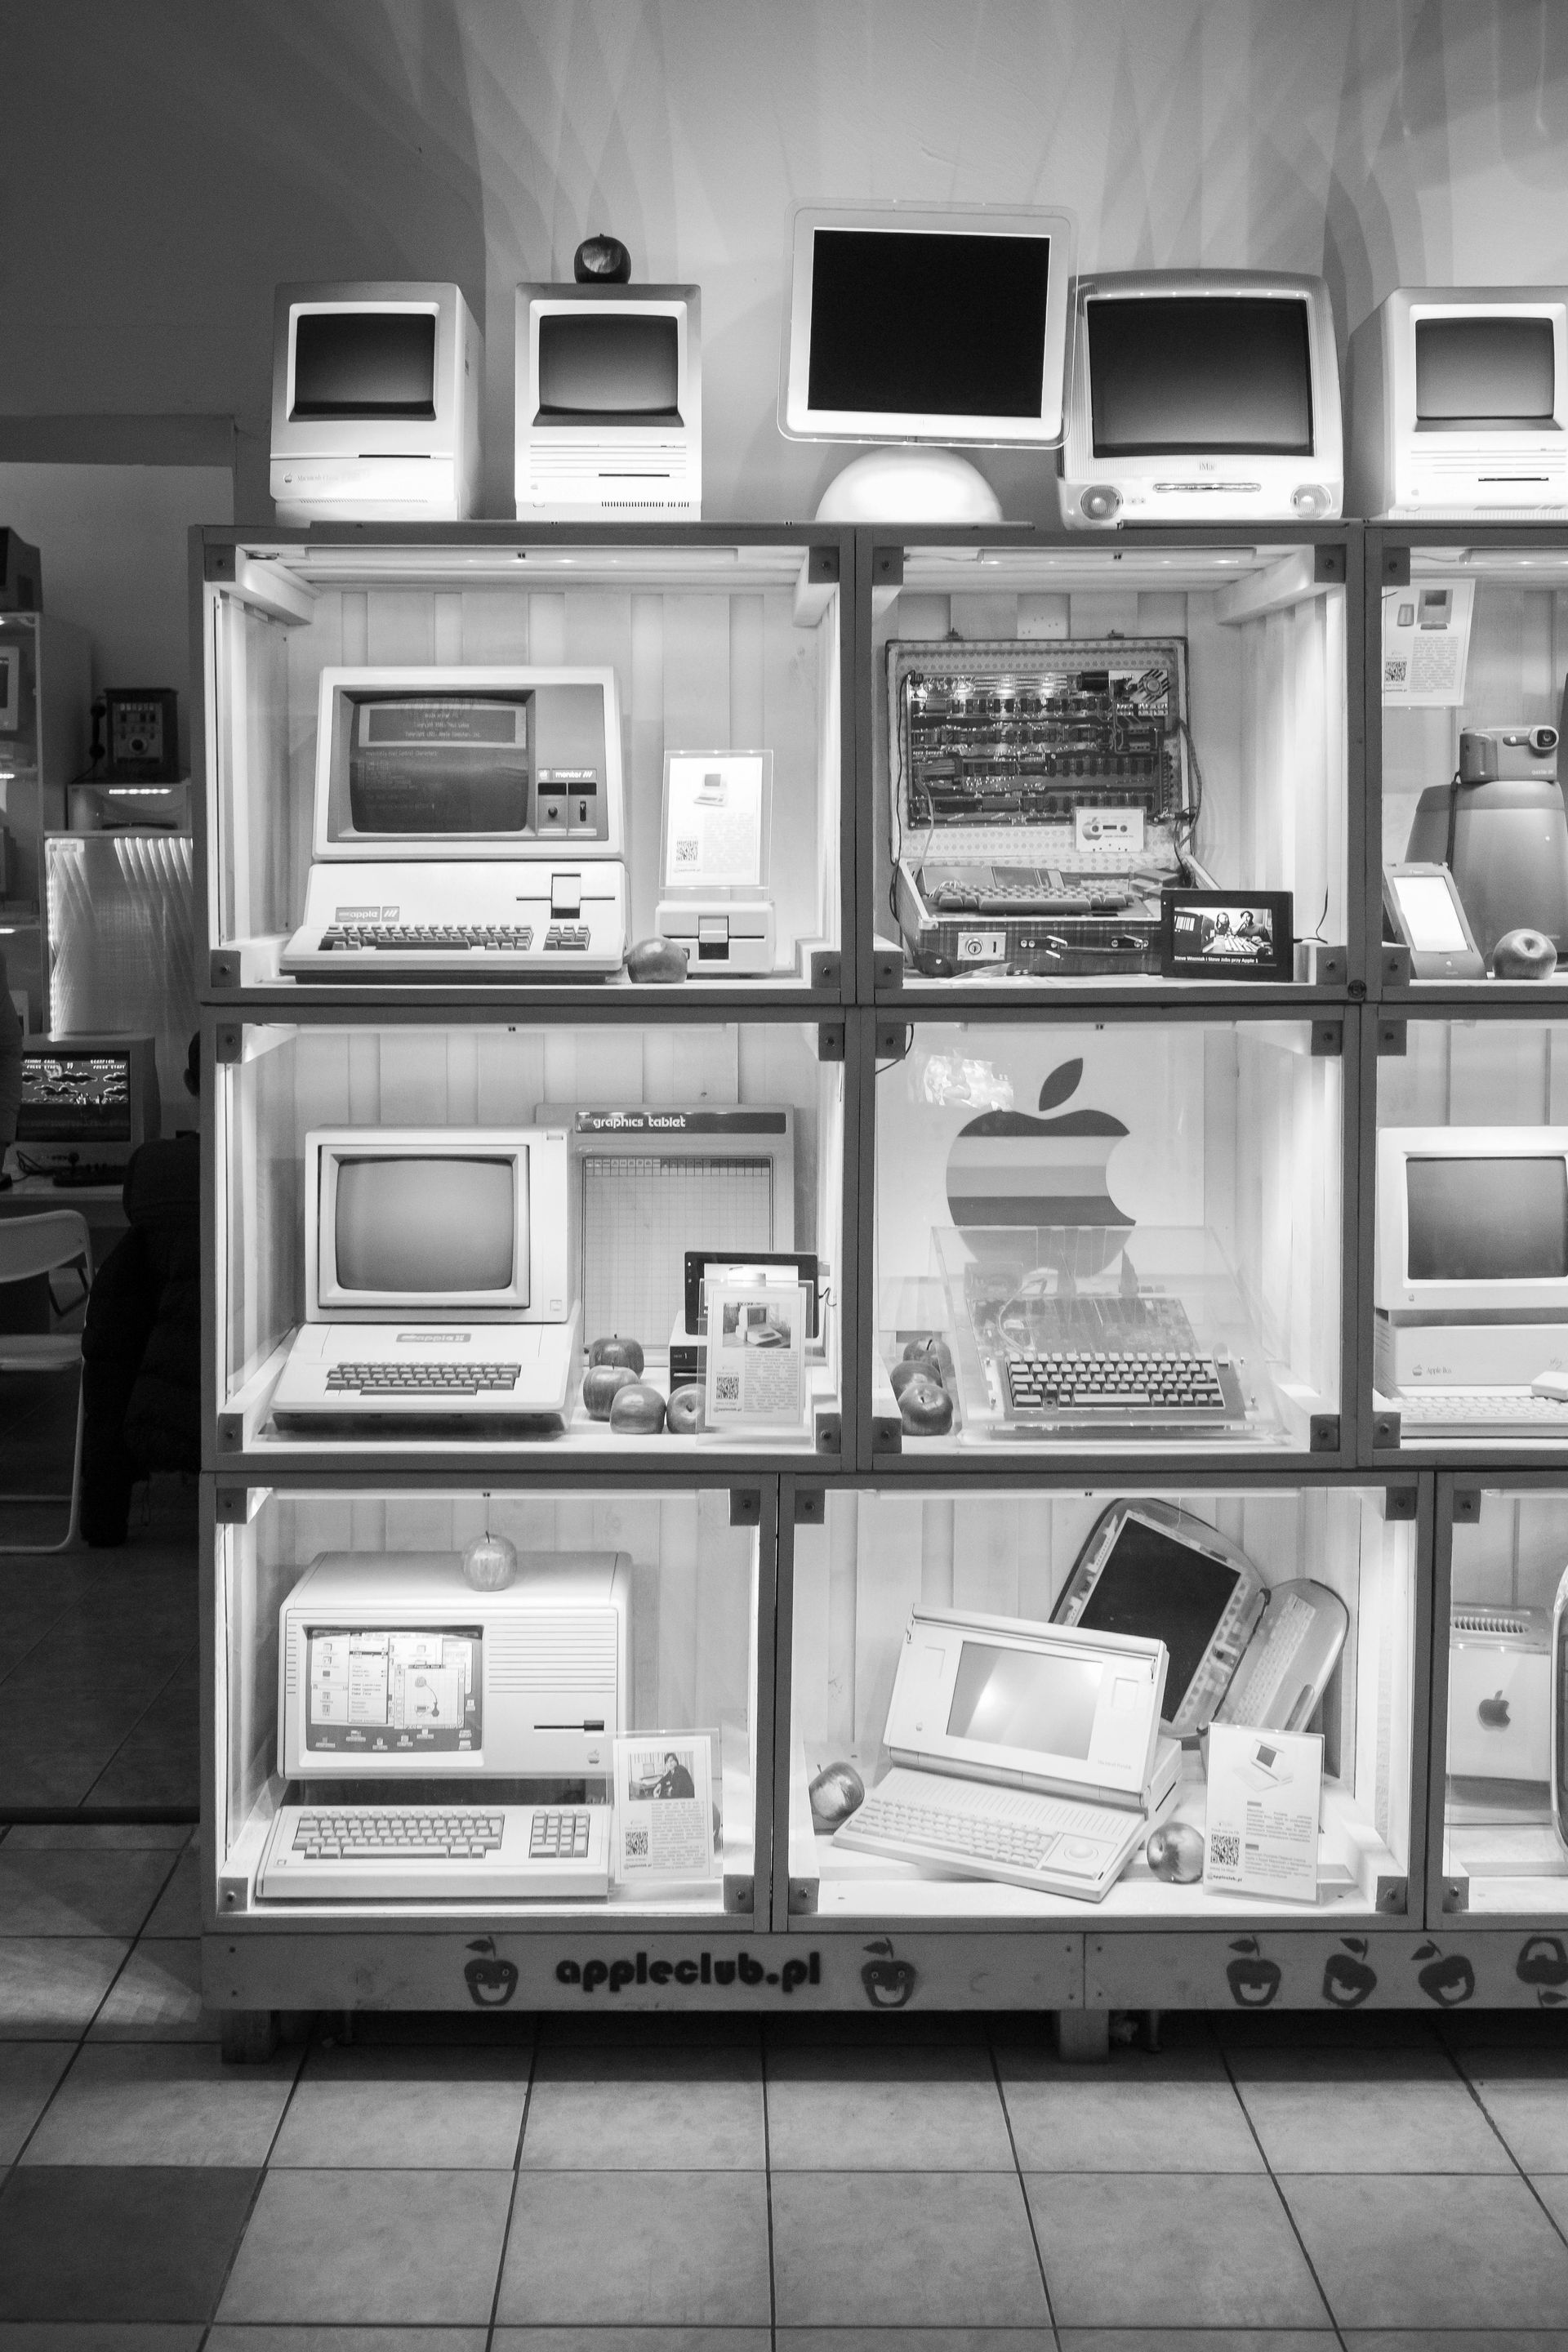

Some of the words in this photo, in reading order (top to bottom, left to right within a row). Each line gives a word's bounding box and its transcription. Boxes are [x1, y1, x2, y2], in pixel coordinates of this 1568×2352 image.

[350, 910, 378, 919] apple
[593, 1116, 644, 1129] graphics
[648, 1115, 686, 1128] tablet
[555, 1951, 821, 1993] appleclub.pl
